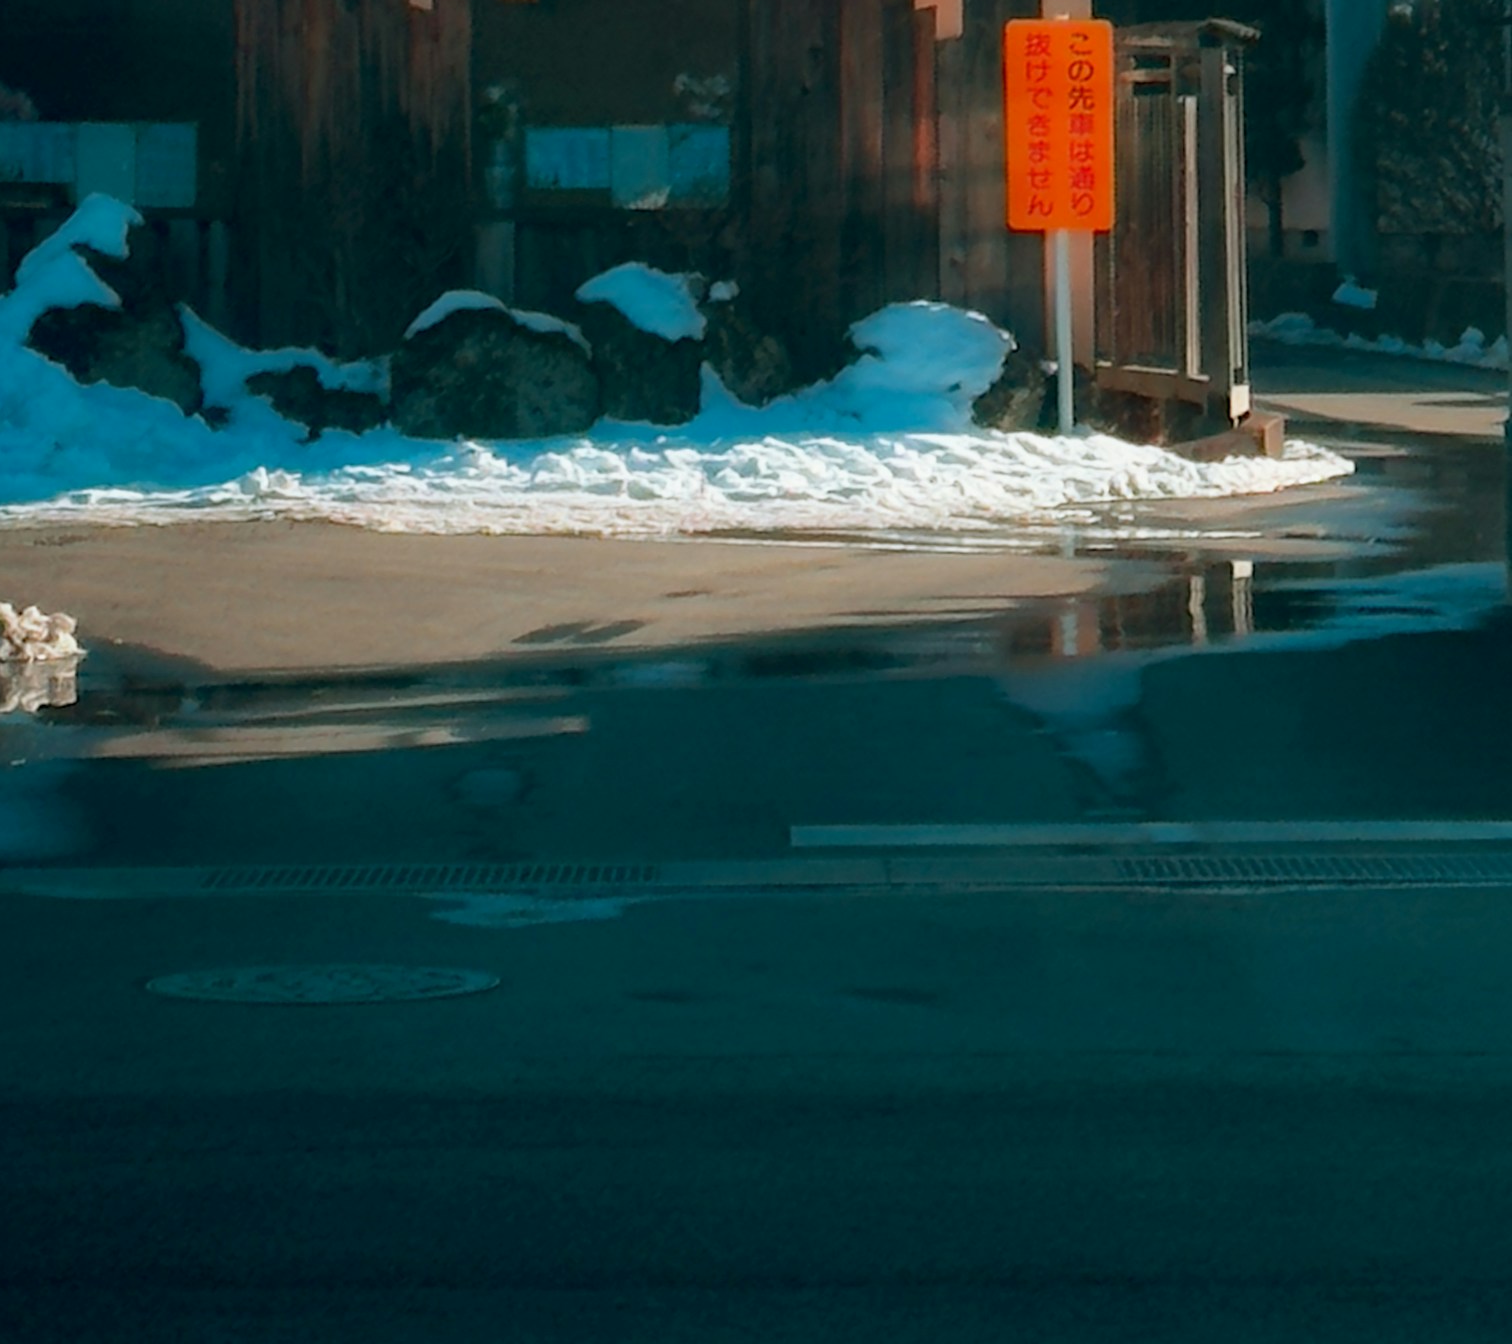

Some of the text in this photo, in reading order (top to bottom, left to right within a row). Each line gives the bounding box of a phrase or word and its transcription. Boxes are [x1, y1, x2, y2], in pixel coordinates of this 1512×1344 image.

[1025, 32, 1054, 217] 抜けできません
[1068, 32, 1095, 217] この先車は通り
